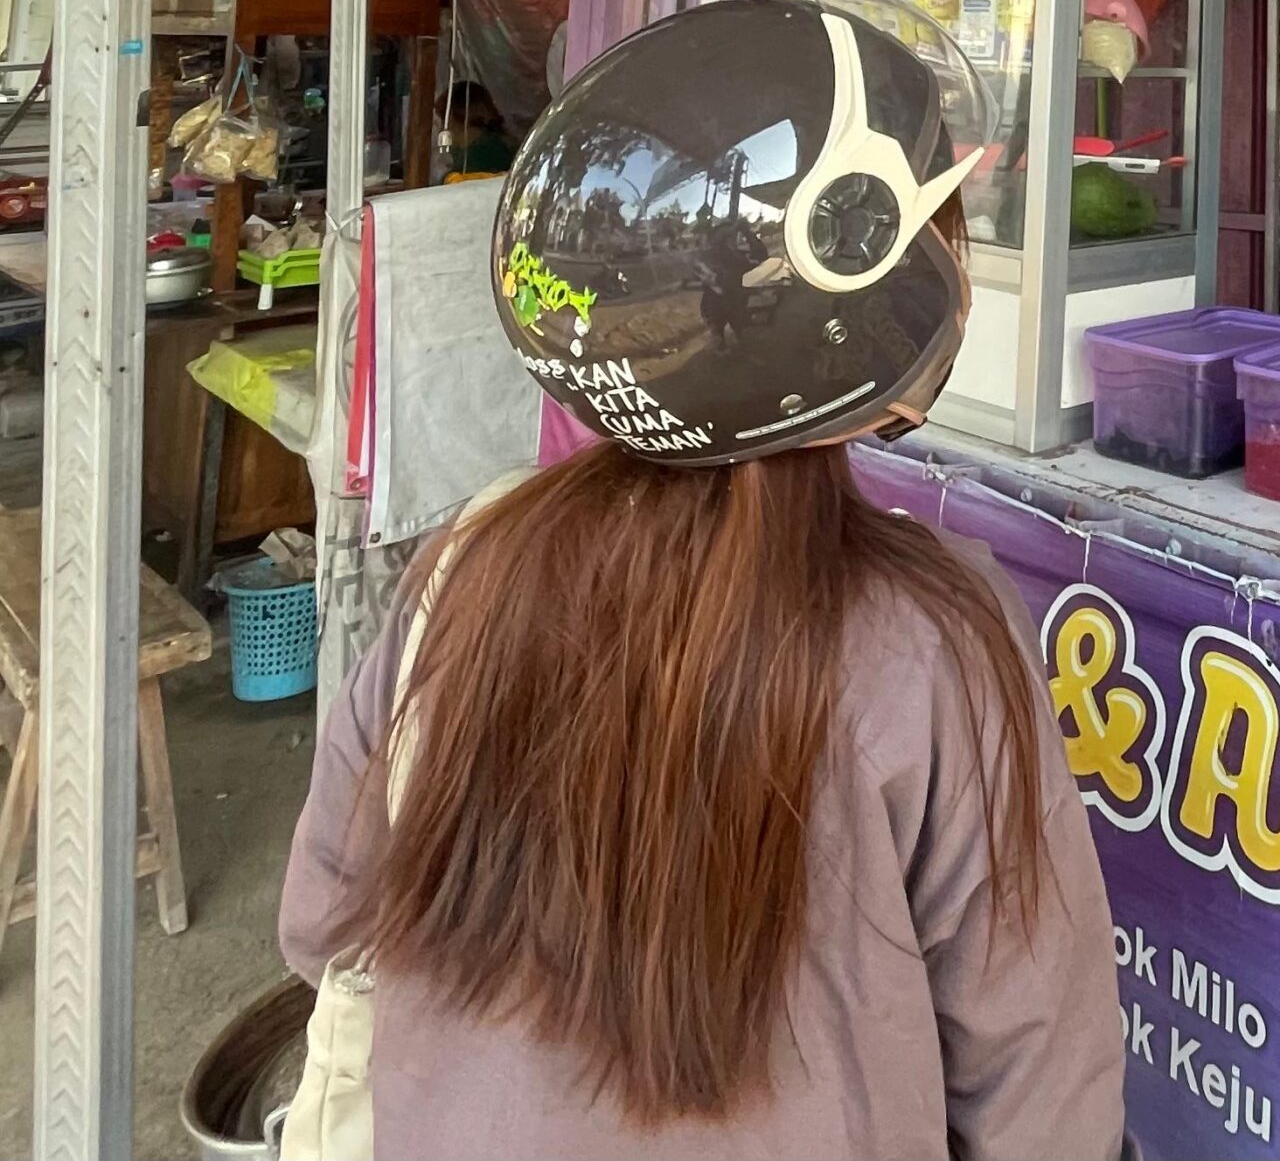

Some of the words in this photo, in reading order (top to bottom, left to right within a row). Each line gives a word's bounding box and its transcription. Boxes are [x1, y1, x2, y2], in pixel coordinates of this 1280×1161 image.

[585, 385, 659, 415] KITA
[1172, 948, 1267, 1049] Milo
[1169, 1027, 1272, 1143] Keju
